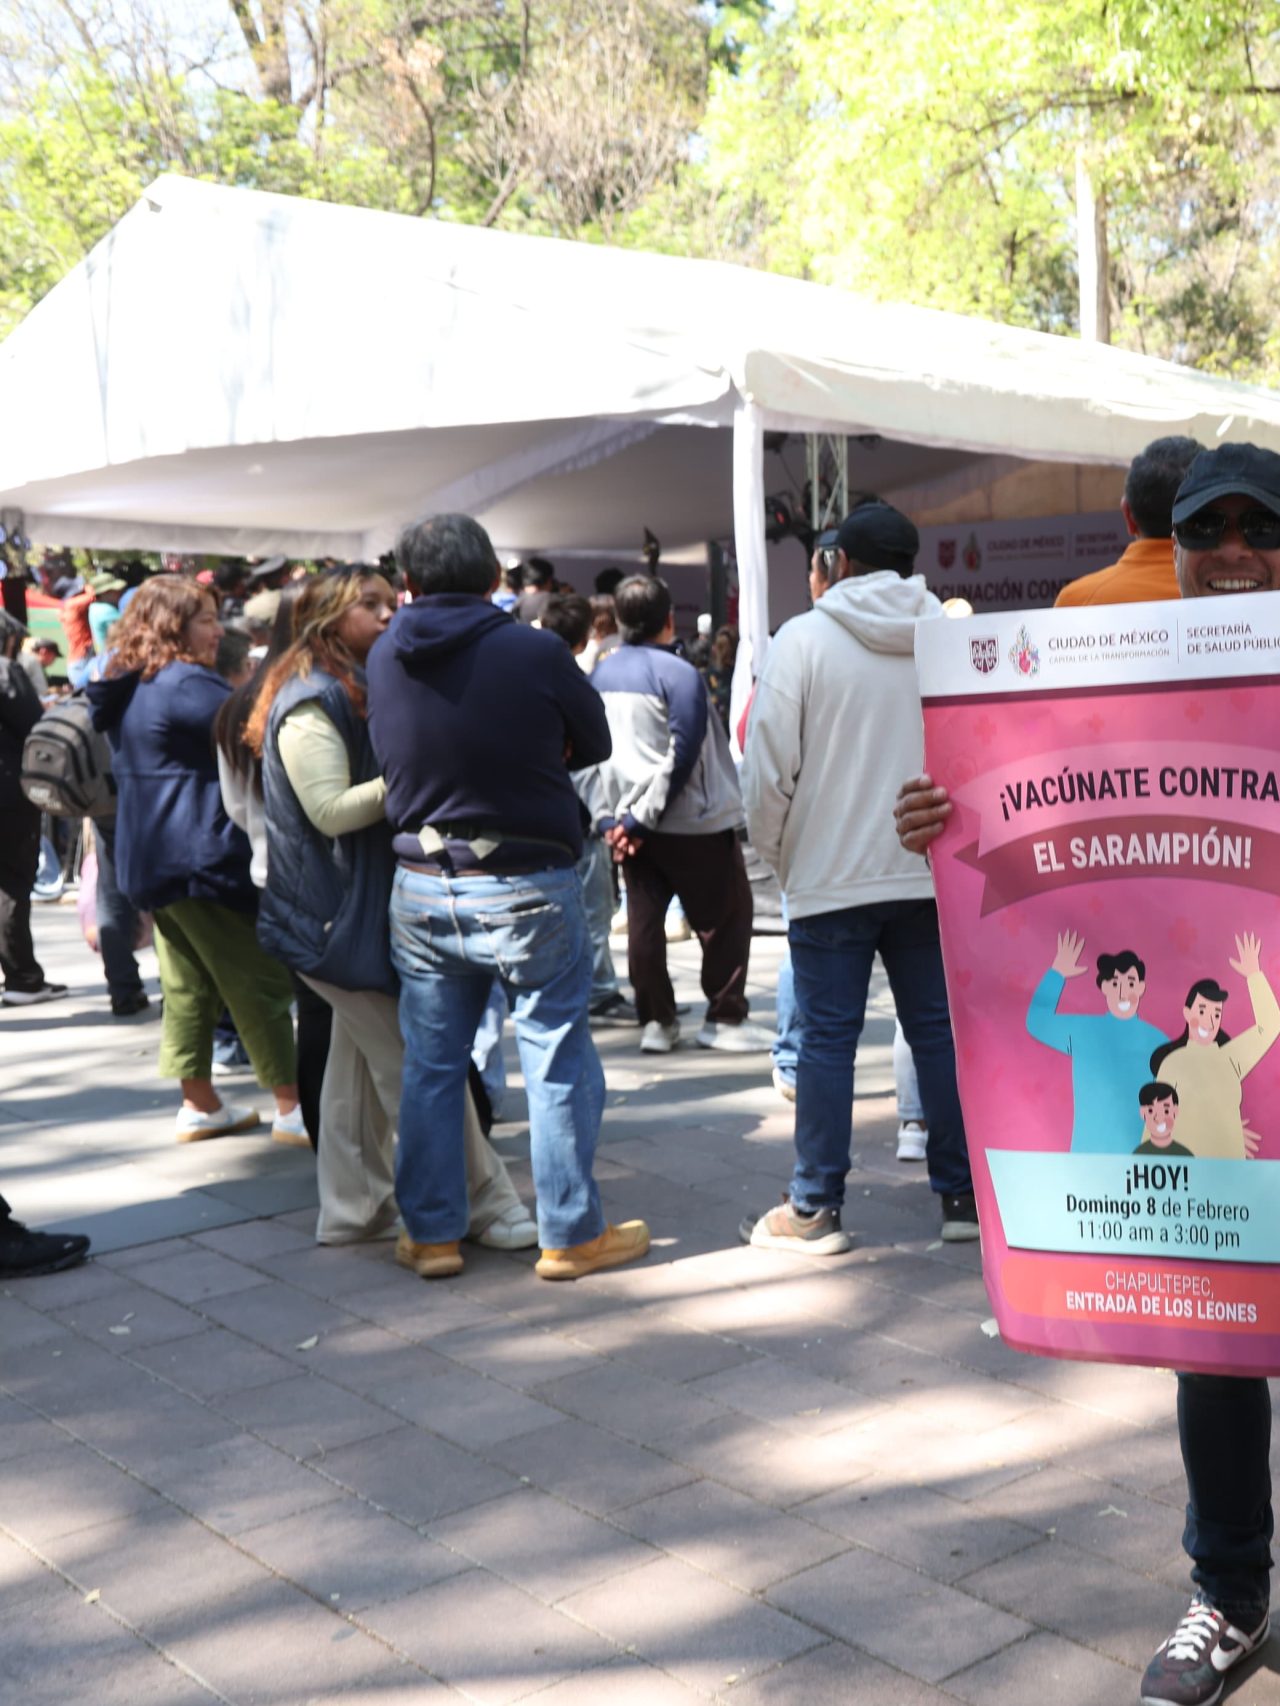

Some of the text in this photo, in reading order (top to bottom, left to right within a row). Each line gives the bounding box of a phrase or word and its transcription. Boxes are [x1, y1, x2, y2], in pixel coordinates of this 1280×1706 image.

[929, 576, 1023, 604] ACUNACIÓN
[1048, 629, 1169, 650] CIUDAD DE MÉXICO
[1186, 621, 1252, 639] SECRETARÍA
[1187, 642, 1202, 655] DE
[1204, 640, 1242, 654] SALUD
[1000, 766, 1280, 821] ¡VACÚNATE CONTRA
[1033, 826, 1252, 874] EL SARAMPIÓN!
[1126, 1164, 1189, 1195] ¡HOY!
[1066, 1194, 1249, 1222] Domingo 8 de Febrero
[1077, 1220, 1240, 1251] 11:00 am a 3:00 pm
[1105, 1271, 1214, 1299] CHAPULTEPEC,
[1066, 1291, 1258, 1323] ENTRADA DE LOS LEONES
